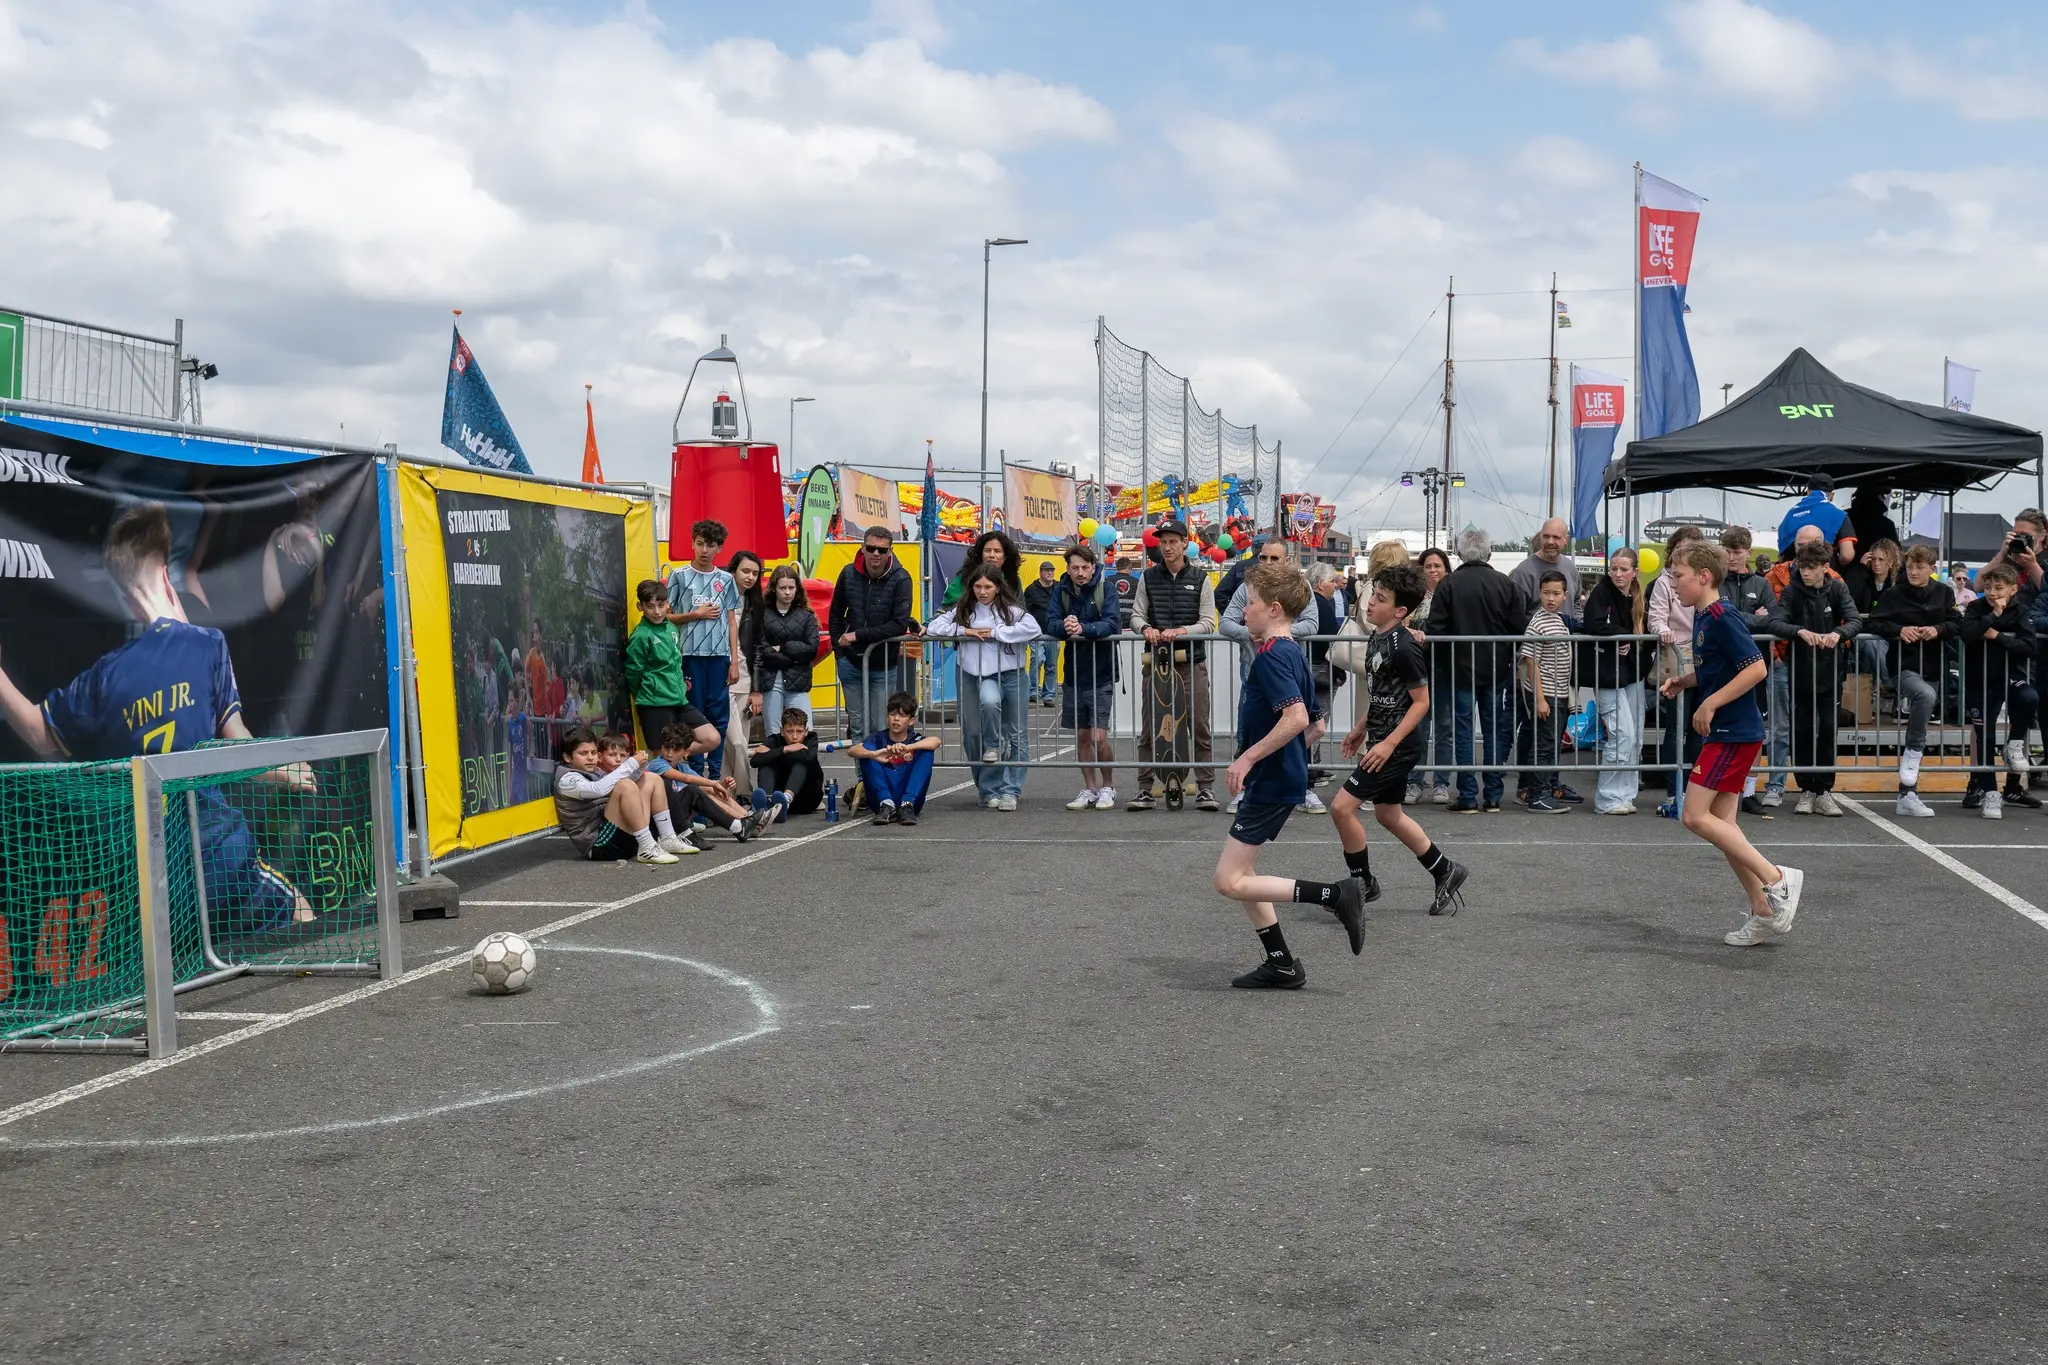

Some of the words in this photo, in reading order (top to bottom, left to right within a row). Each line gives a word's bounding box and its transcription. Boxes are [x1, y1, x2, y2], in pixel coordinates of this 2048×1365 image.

[1585, 409, 1615, 417] GOALS
[1779, 404, 1835, 419] BNT
[810, 482, 829, 495] BEKER
[808, 498, 831, 510] INNAME
[855, 493, 888, 519] TOILETTEN
[1024, 495, 1063, 522] TOILETTEN
[447, 509, 511, 535] STRAATVOETBAL
[466, 538, 473, 557] 2
[482, 537, 489, 556] 2
[453, 562, 501, 586] HARDERWIJK
[123, 689, 163, 732] VINI
[169, 681, 195, 712] JR.
[464, 752, 508, 814] BNT
[311, 821, 377, 913] BN
